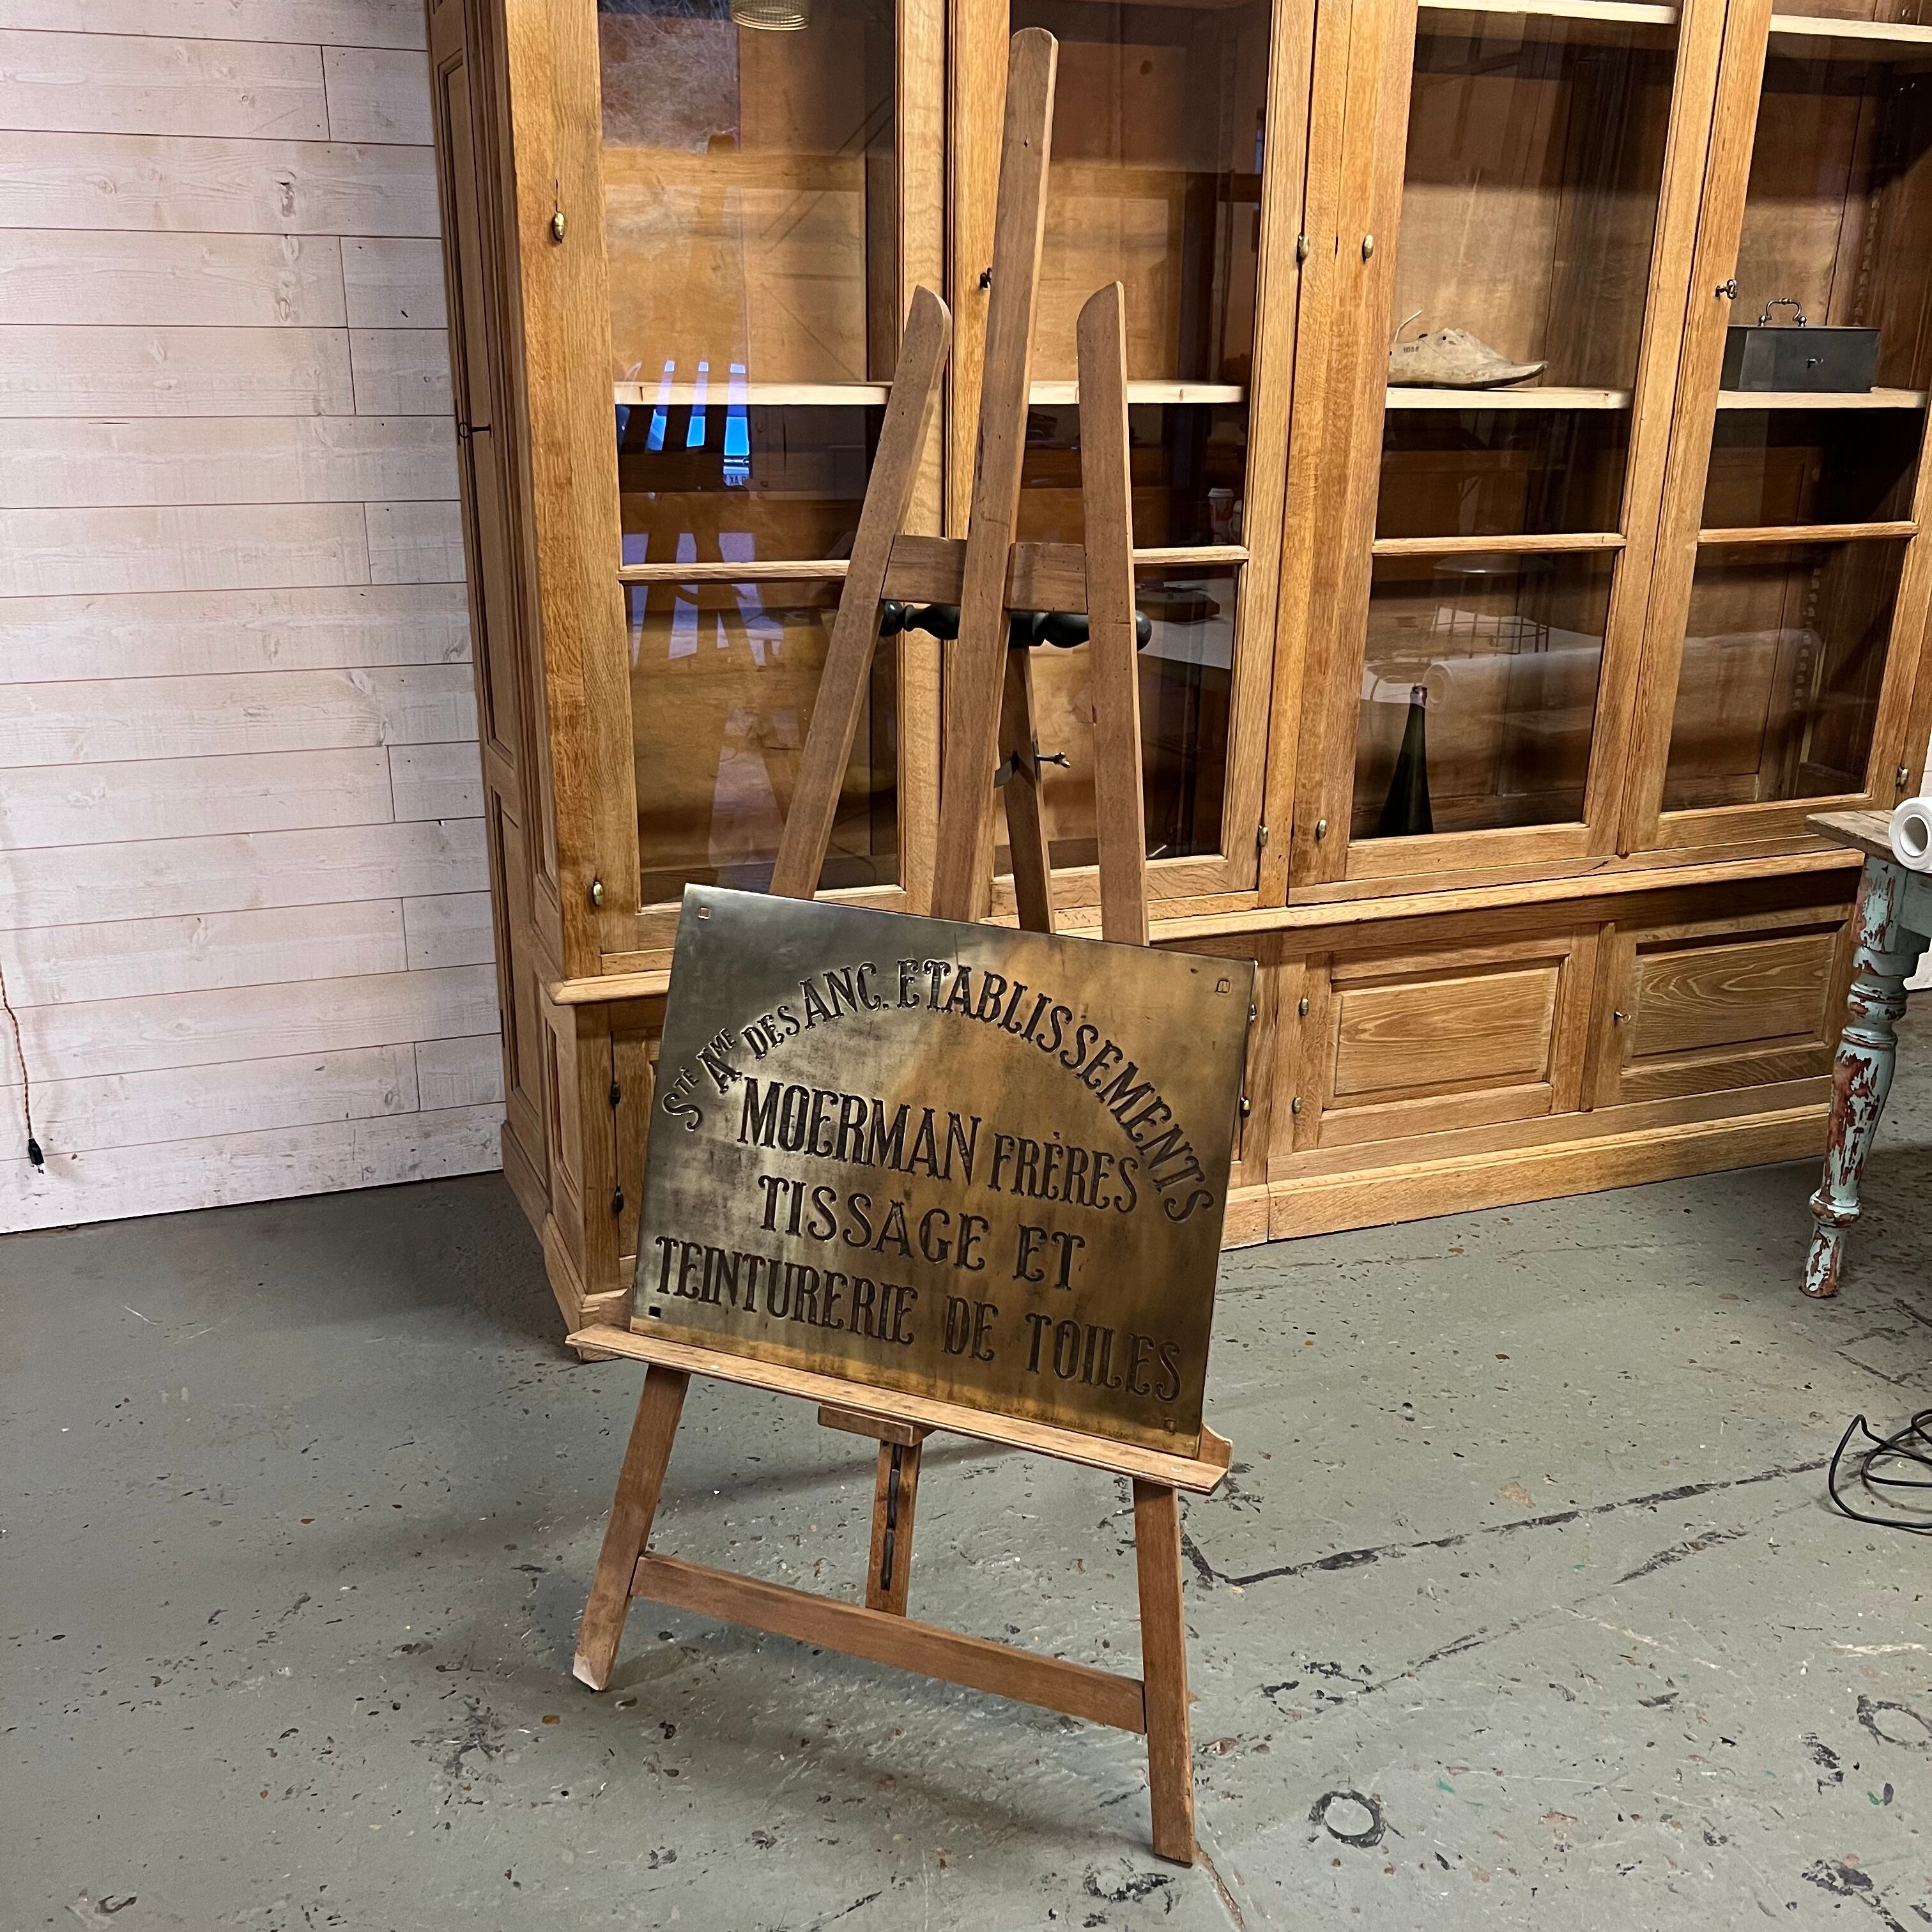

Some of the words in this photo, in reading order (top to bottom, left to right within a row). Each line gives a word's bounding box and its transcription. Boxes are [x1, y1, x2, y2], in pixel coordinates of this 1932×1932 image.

[737, 1077, 983, 1186] MOERMAN
[742, 1005, 801, 1061] DES
[799, 962, 889, 1030] ANC.
[896, 959, 1215, 1223] ETABLISSEMENTS
[758, 1174, 990, 1271] TISSAGE
[1013, 1223, 1086, 1291] ET
[655, 1235, 919, 1346] TEINTURERIE
[941, 1294, 999, 1362] DE
[1025, 1312, 1182, 1402] TOILES
